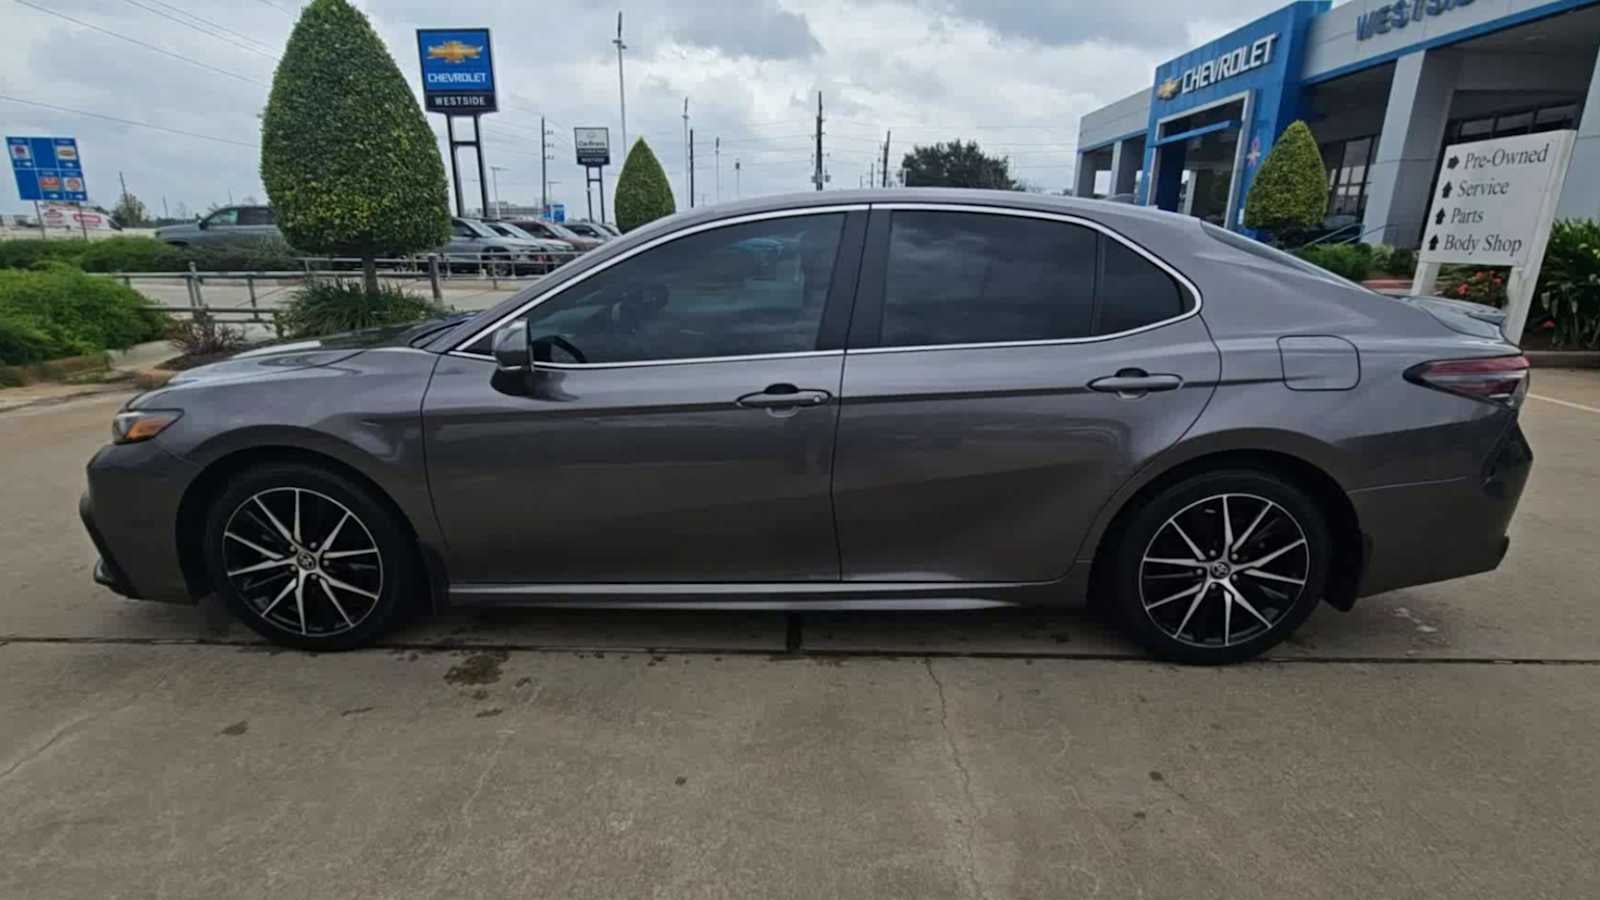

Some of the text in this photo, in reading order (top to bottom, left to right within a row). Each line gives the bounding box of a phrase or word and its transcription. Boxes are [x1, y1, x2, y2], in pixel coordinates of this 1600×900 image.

[1182, 33, 1278, 94] CHEVROLET
[427, 72, 487, 83] CHEVROLET
[434, 96, 486, 106] WESTSIDE
[1464, 143, 1550, 170] Pre-Owned
[1457, 177, 1510, 198] Service
[1450, 207, 1485, 225] Parts
[1443, 233, 1523, 257] Body Shop
